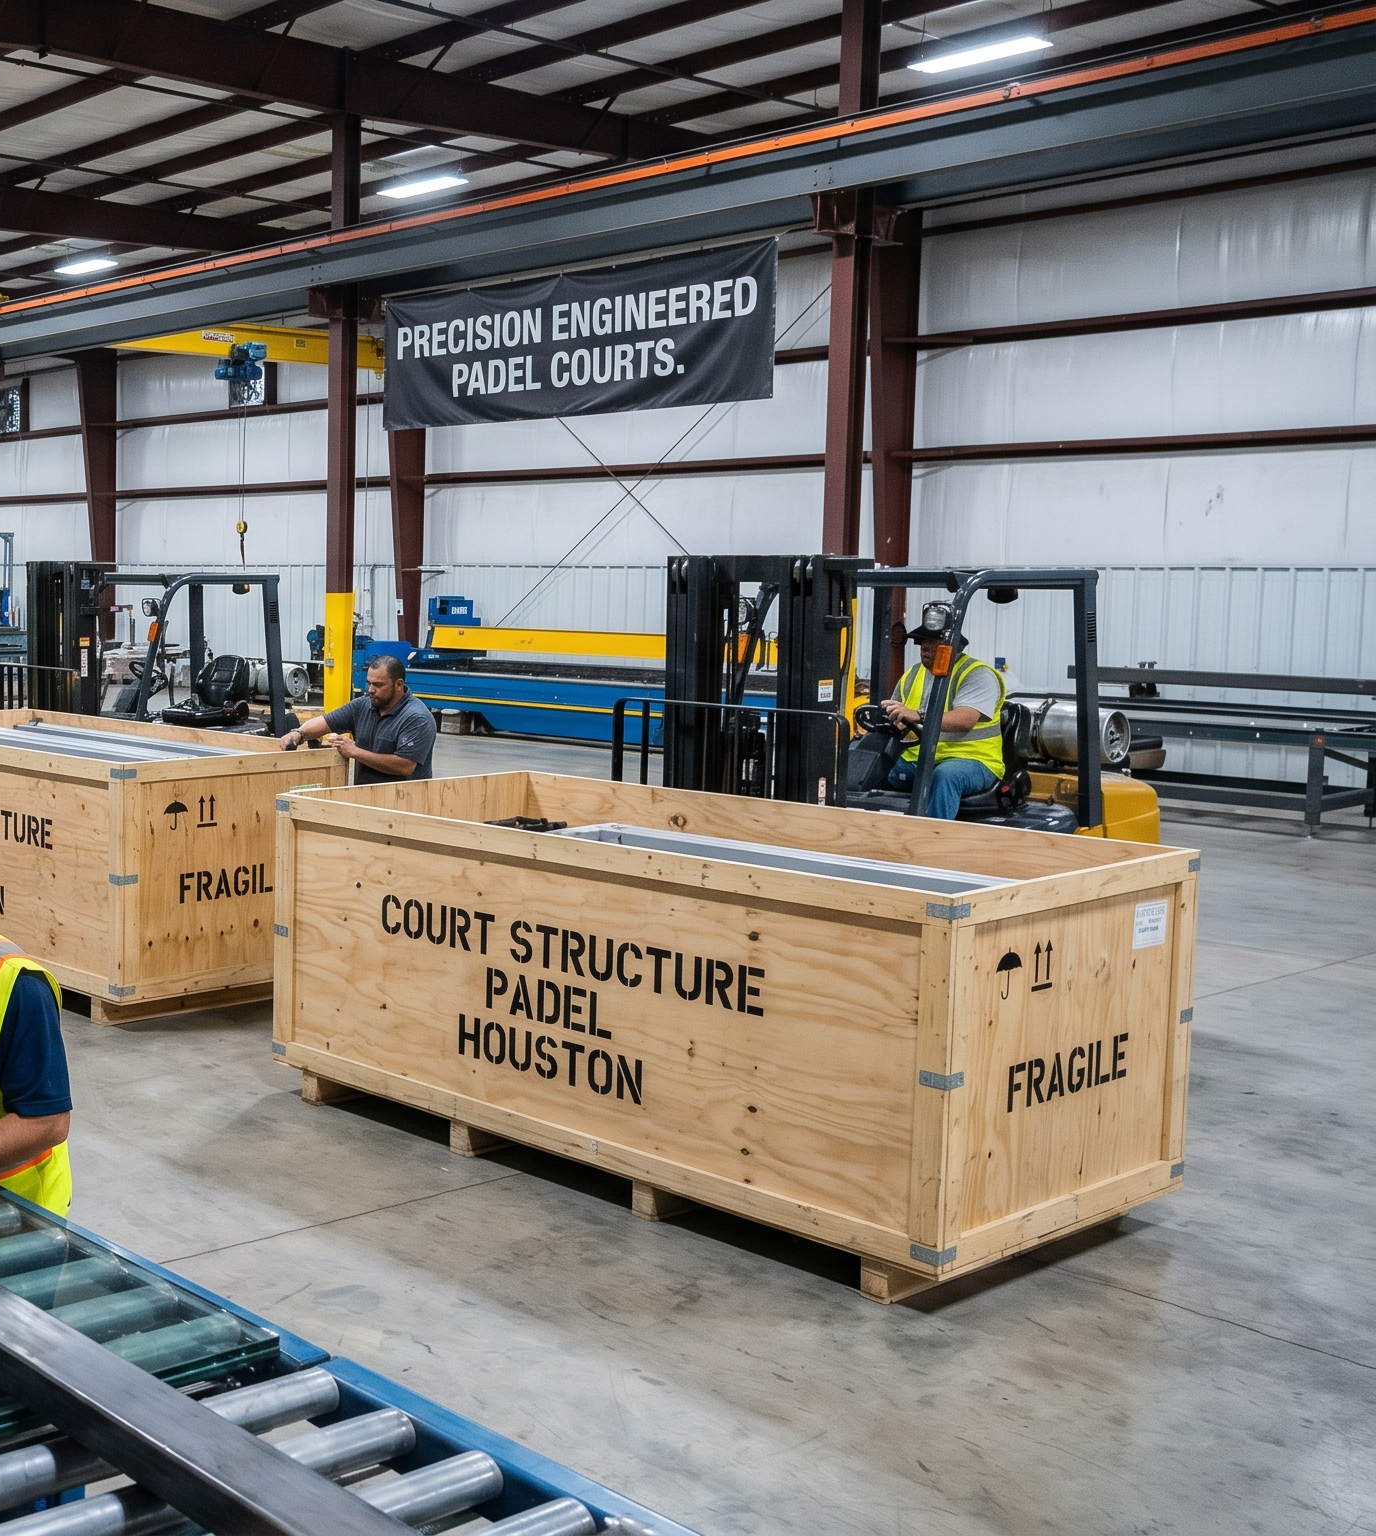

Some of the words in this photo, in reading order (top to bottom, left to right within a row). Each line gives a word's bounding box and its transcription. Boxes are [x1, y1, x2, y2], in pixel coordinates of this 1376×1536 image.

[396, 306, 543, 361] PRECISION
[551, 275, 759, 342] ENGINEERED
[452, 355, 542, 399] PADEL
[550, 337, 685, 389] COURTS.
[179, 863, 273, 904] FRAGIL
[381, 894, 495, 957] COURT
[510, 920, 765, 1017] STRUCTURE
[486, 966, 613, 1040] PADEL
[458, 1013, 643, 1106] HOUSTON
[1007, 1032, 1130, 1113] FRAGILE
